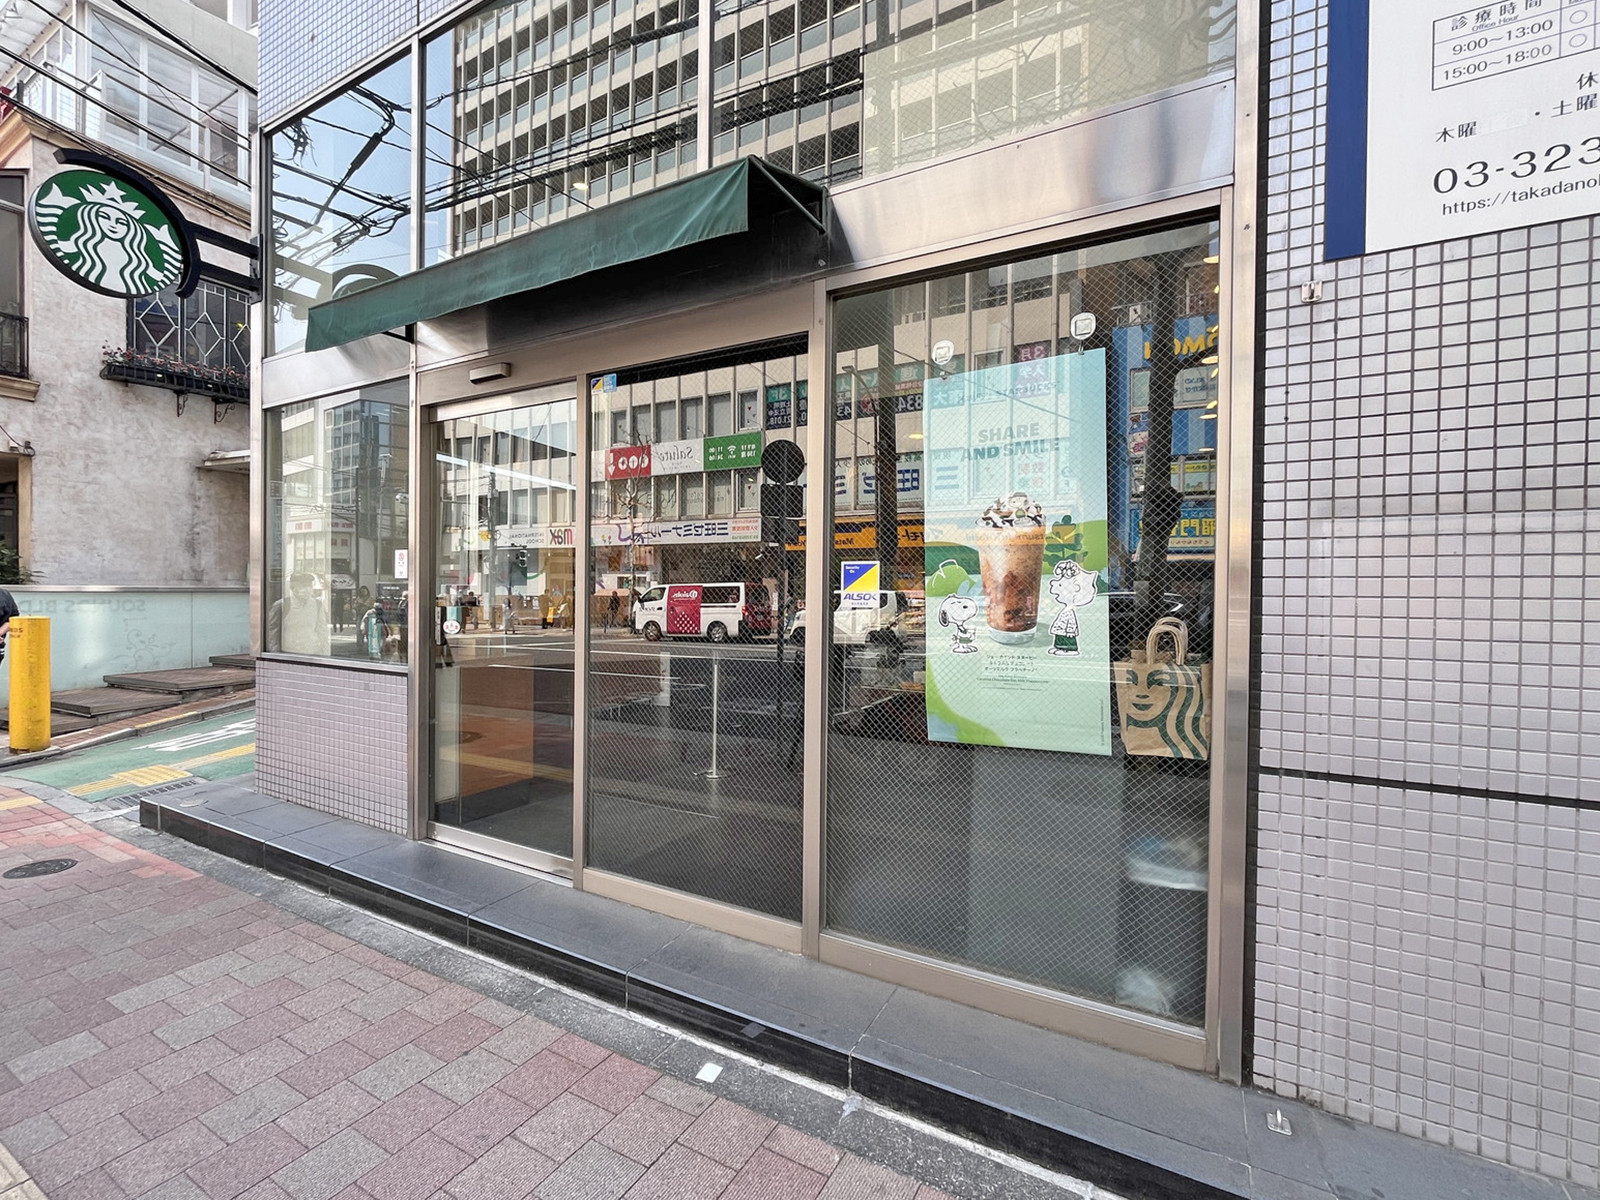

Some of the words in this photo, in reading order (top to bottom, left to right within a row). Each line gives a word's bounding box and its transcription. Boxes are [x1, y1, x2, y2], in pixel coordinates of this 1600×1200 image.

[1451, 0, 1543, 31] 診療時間
[1472, 21, 1496, 32] Office
[1498, 14, 1520, 25] Hour
[1435, 121, 1478, 143] 木曜
[1442, 173, 1600, 216] https://takadano
[978, 422, 1040, 443] SHARE
[960, 446, 1000, 462] AND
[1003, 437, 1060, 458] SMILE
[843, 593, 877, 601] ALSOK
